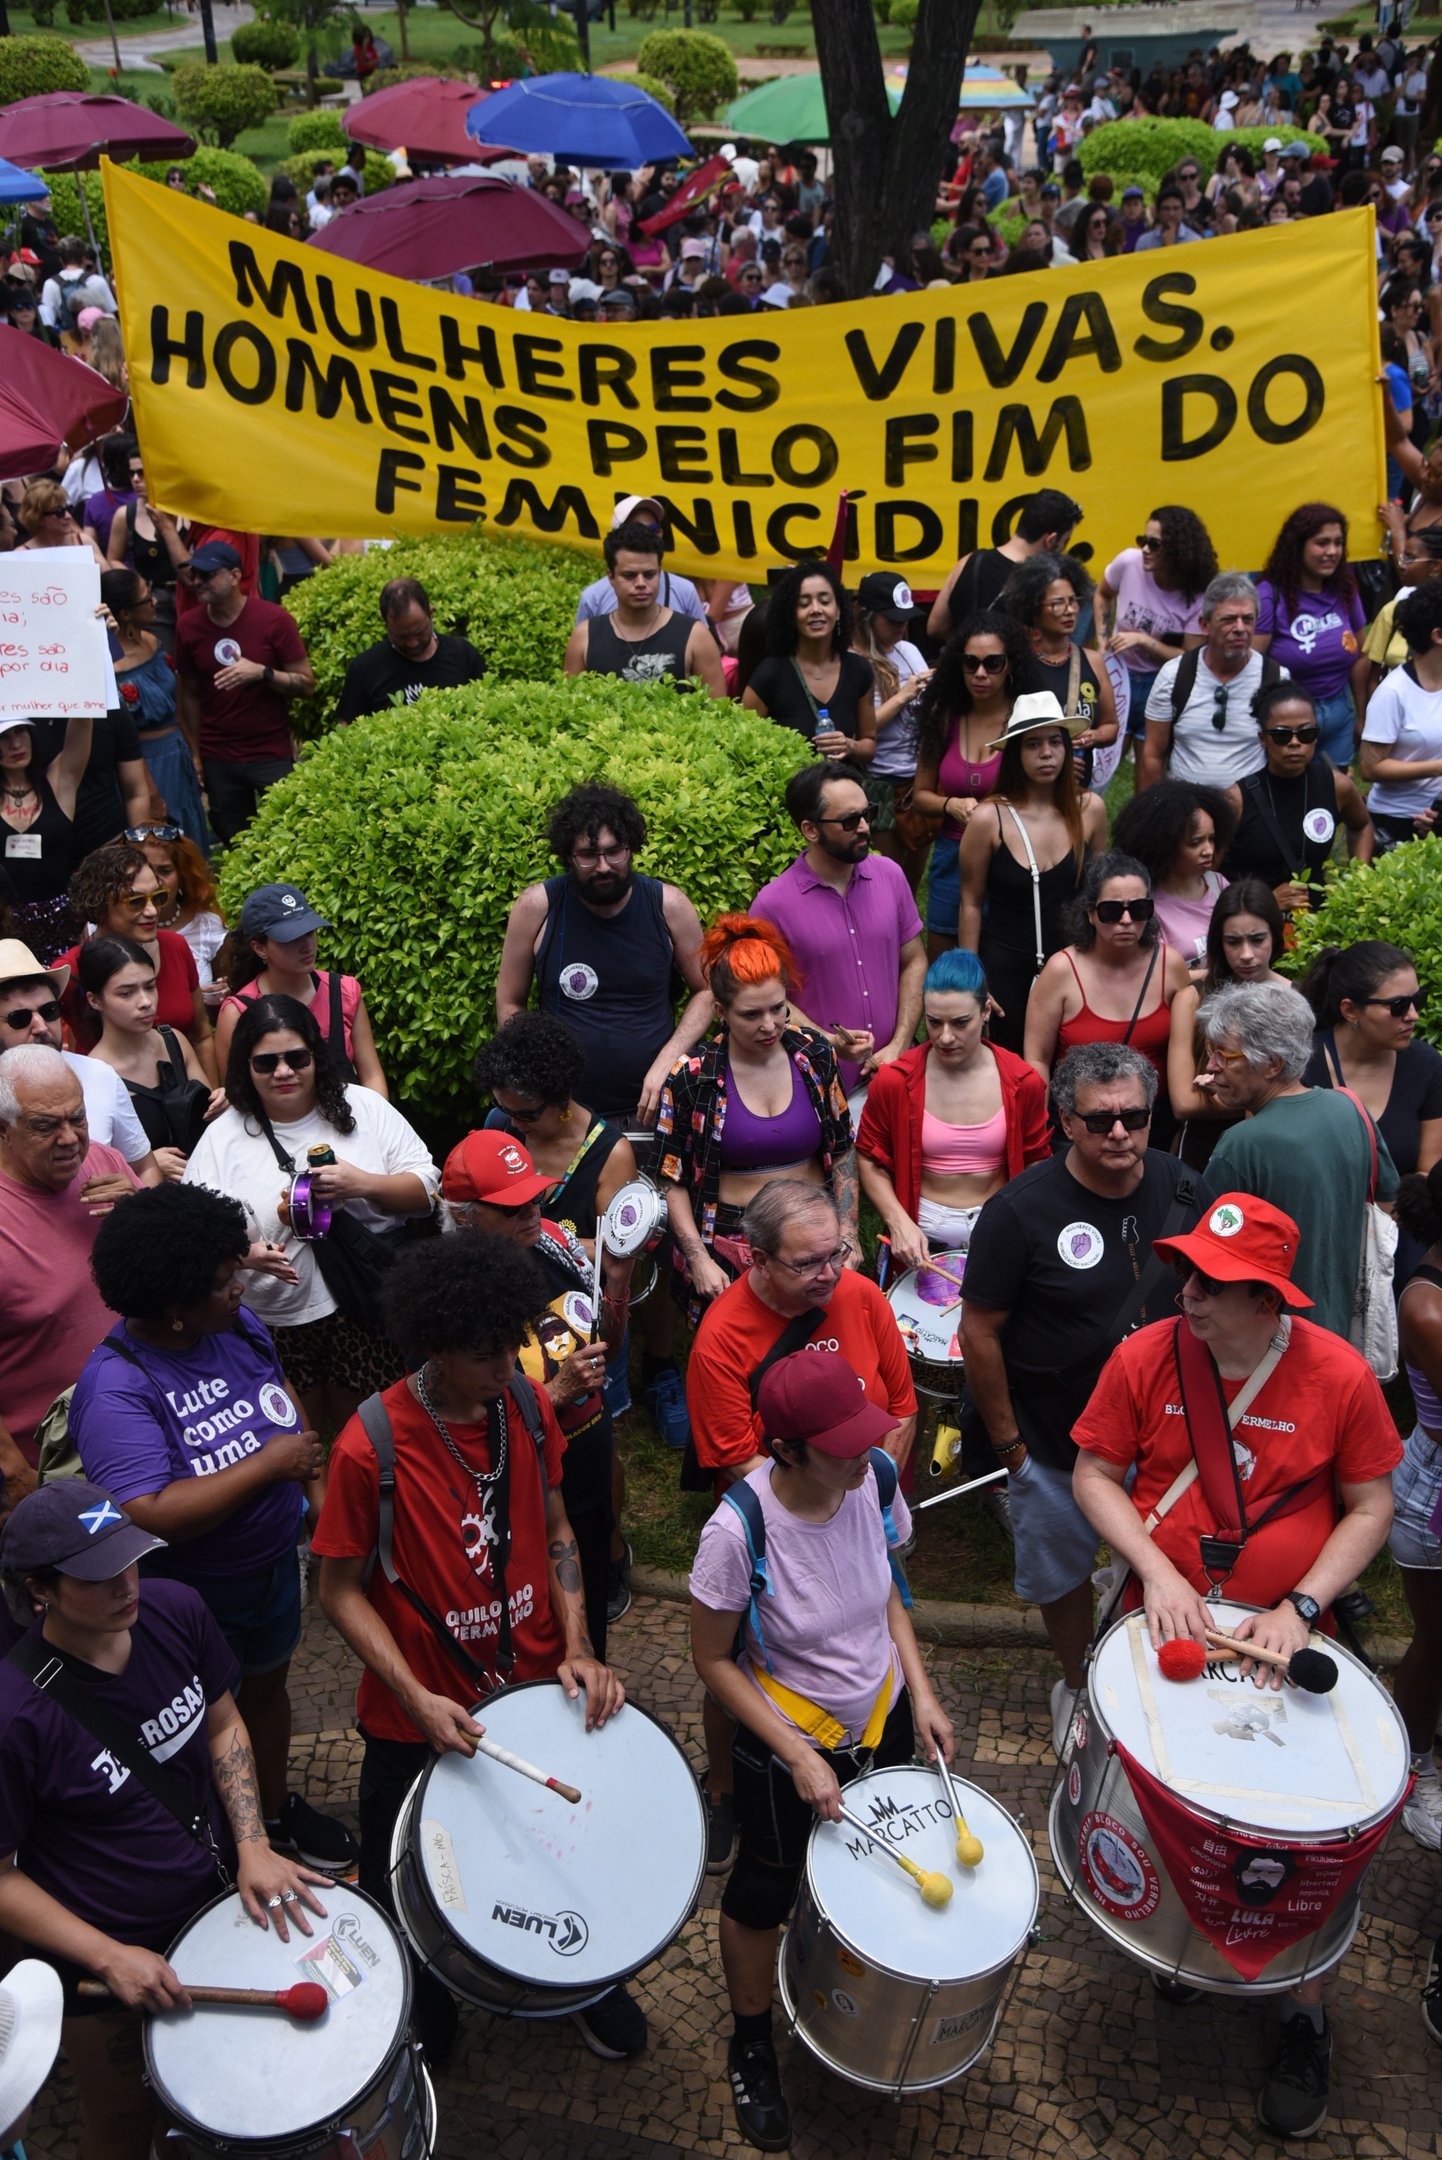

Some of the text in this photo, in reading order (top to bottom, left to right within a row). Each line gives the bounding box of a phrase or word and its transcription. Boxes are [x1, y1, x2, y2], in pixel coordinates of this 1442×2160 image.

[228, 240, 1234, 412] MULHERES VIVAS.
[150, 305, 1325, 489] HOMENS PELO FIM DO
[375, 448, 1095, 564] FEMNICÍDI.
[31, 586, 68, 606] são
[1065, 1223, 1092, 1234] MULHERES
[165, 1377, 230, 1418] Lute
[183, 1399, 255, 1447] como
[1241, 1414, 1296, 1434] ERMELHO
[190, 1430, 262, 1477] uma
[453, 1600, 534, 1642] ERMLHO
[1094, 1813, 1127, 1837] BLOCO
[1130, 1841, 1152, 1869] SOU
[1202, 1839, 1228, 1857] 自由
[1124, 1876, 1159, 1919] VERMELHO
[1287, 1899, 1323, 1912] Libre
[491, 1903, 558, 1940] LUEN
[1226, 1924, 1271, 1946] Livre
[1230, 1909, 1275, 1926] LULA
[348, 1928, 382, 1968] LUEN
